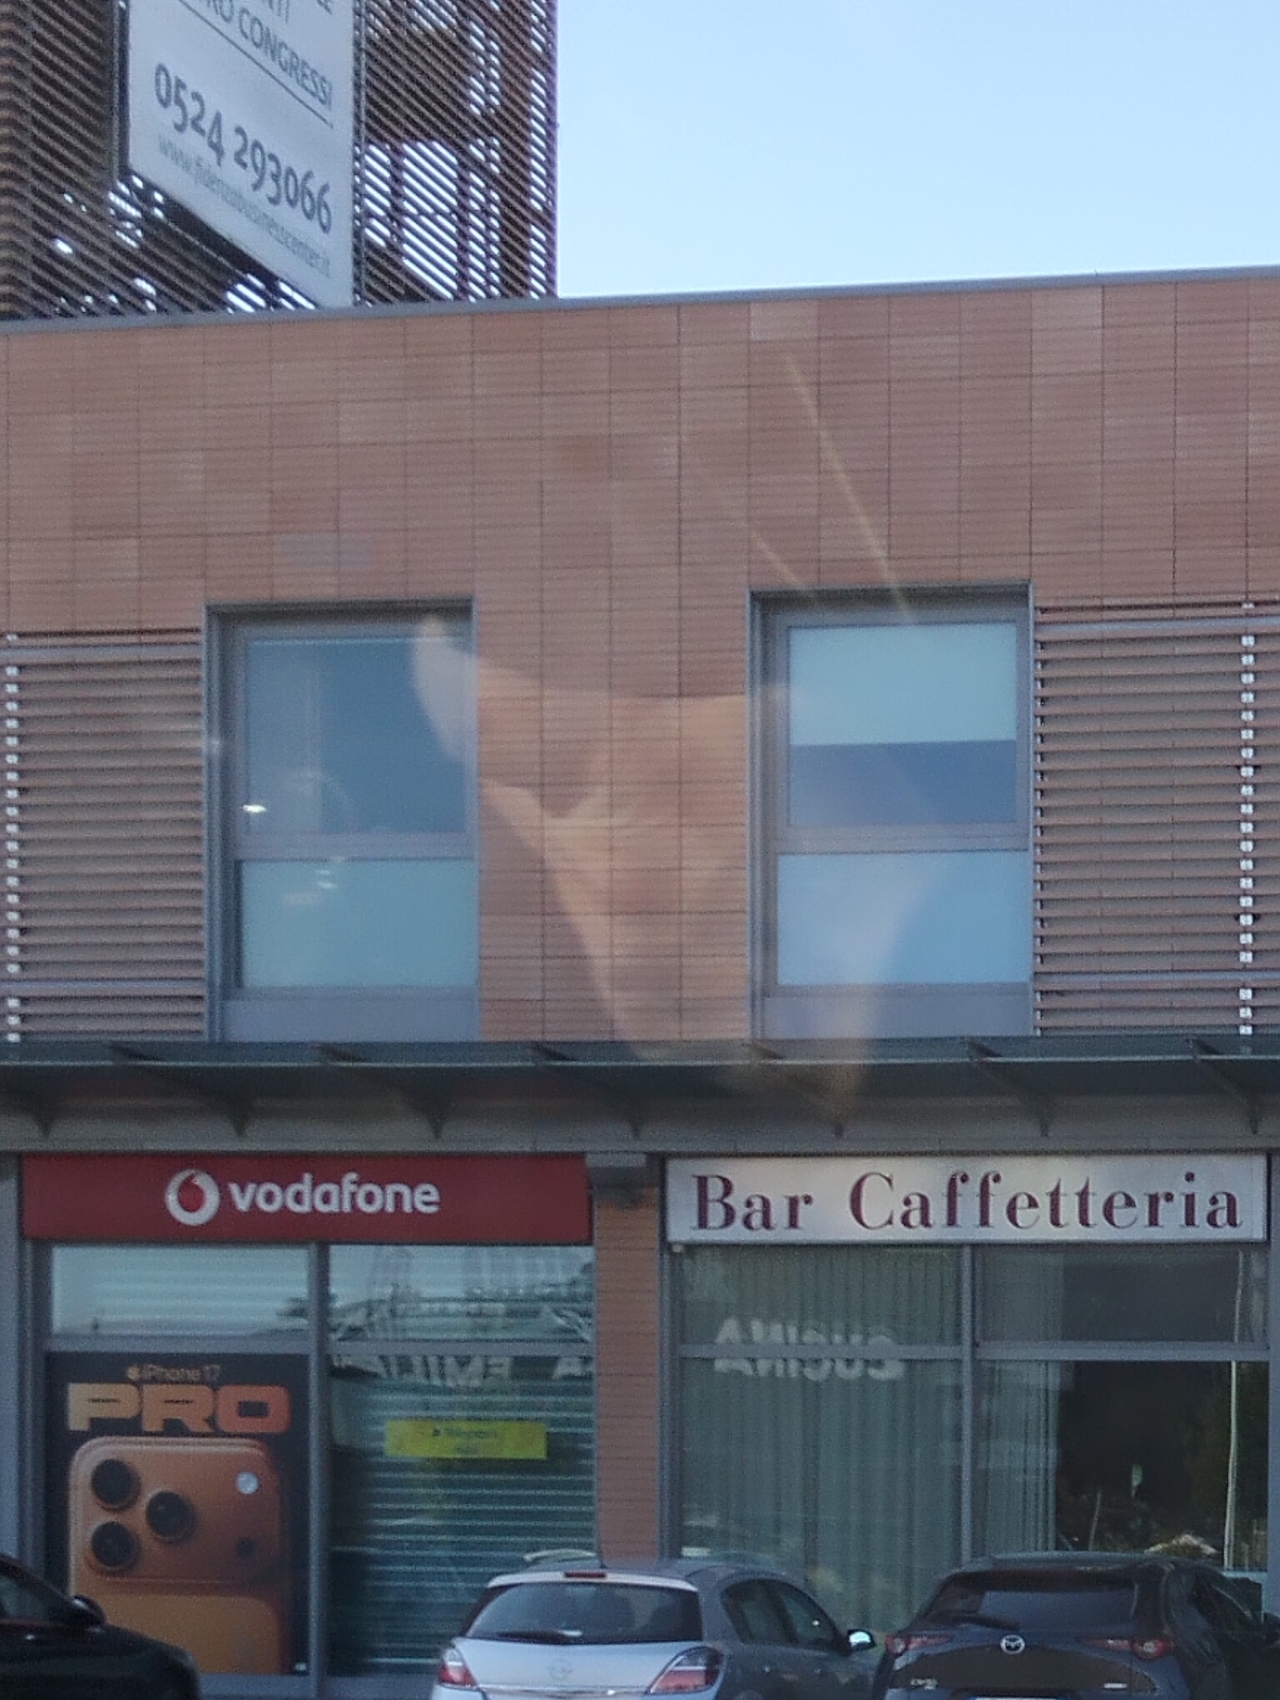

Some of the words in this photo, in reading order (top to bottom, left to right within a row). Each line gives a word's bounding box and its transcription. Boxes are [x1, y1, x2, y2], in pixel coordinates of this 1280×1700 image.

[238, 7, 333, 110] CONGRESSI
[154, 63, 224, 168] 0524
[233, 124, 331, 234] 293066
[228, 1171, 440, 1213] vodafone
[692, 1174, 813, 1231] Bar
[849, 1170, 1244, 1230] Caffetteria
[67, 1382, 292, 1433] PRO
